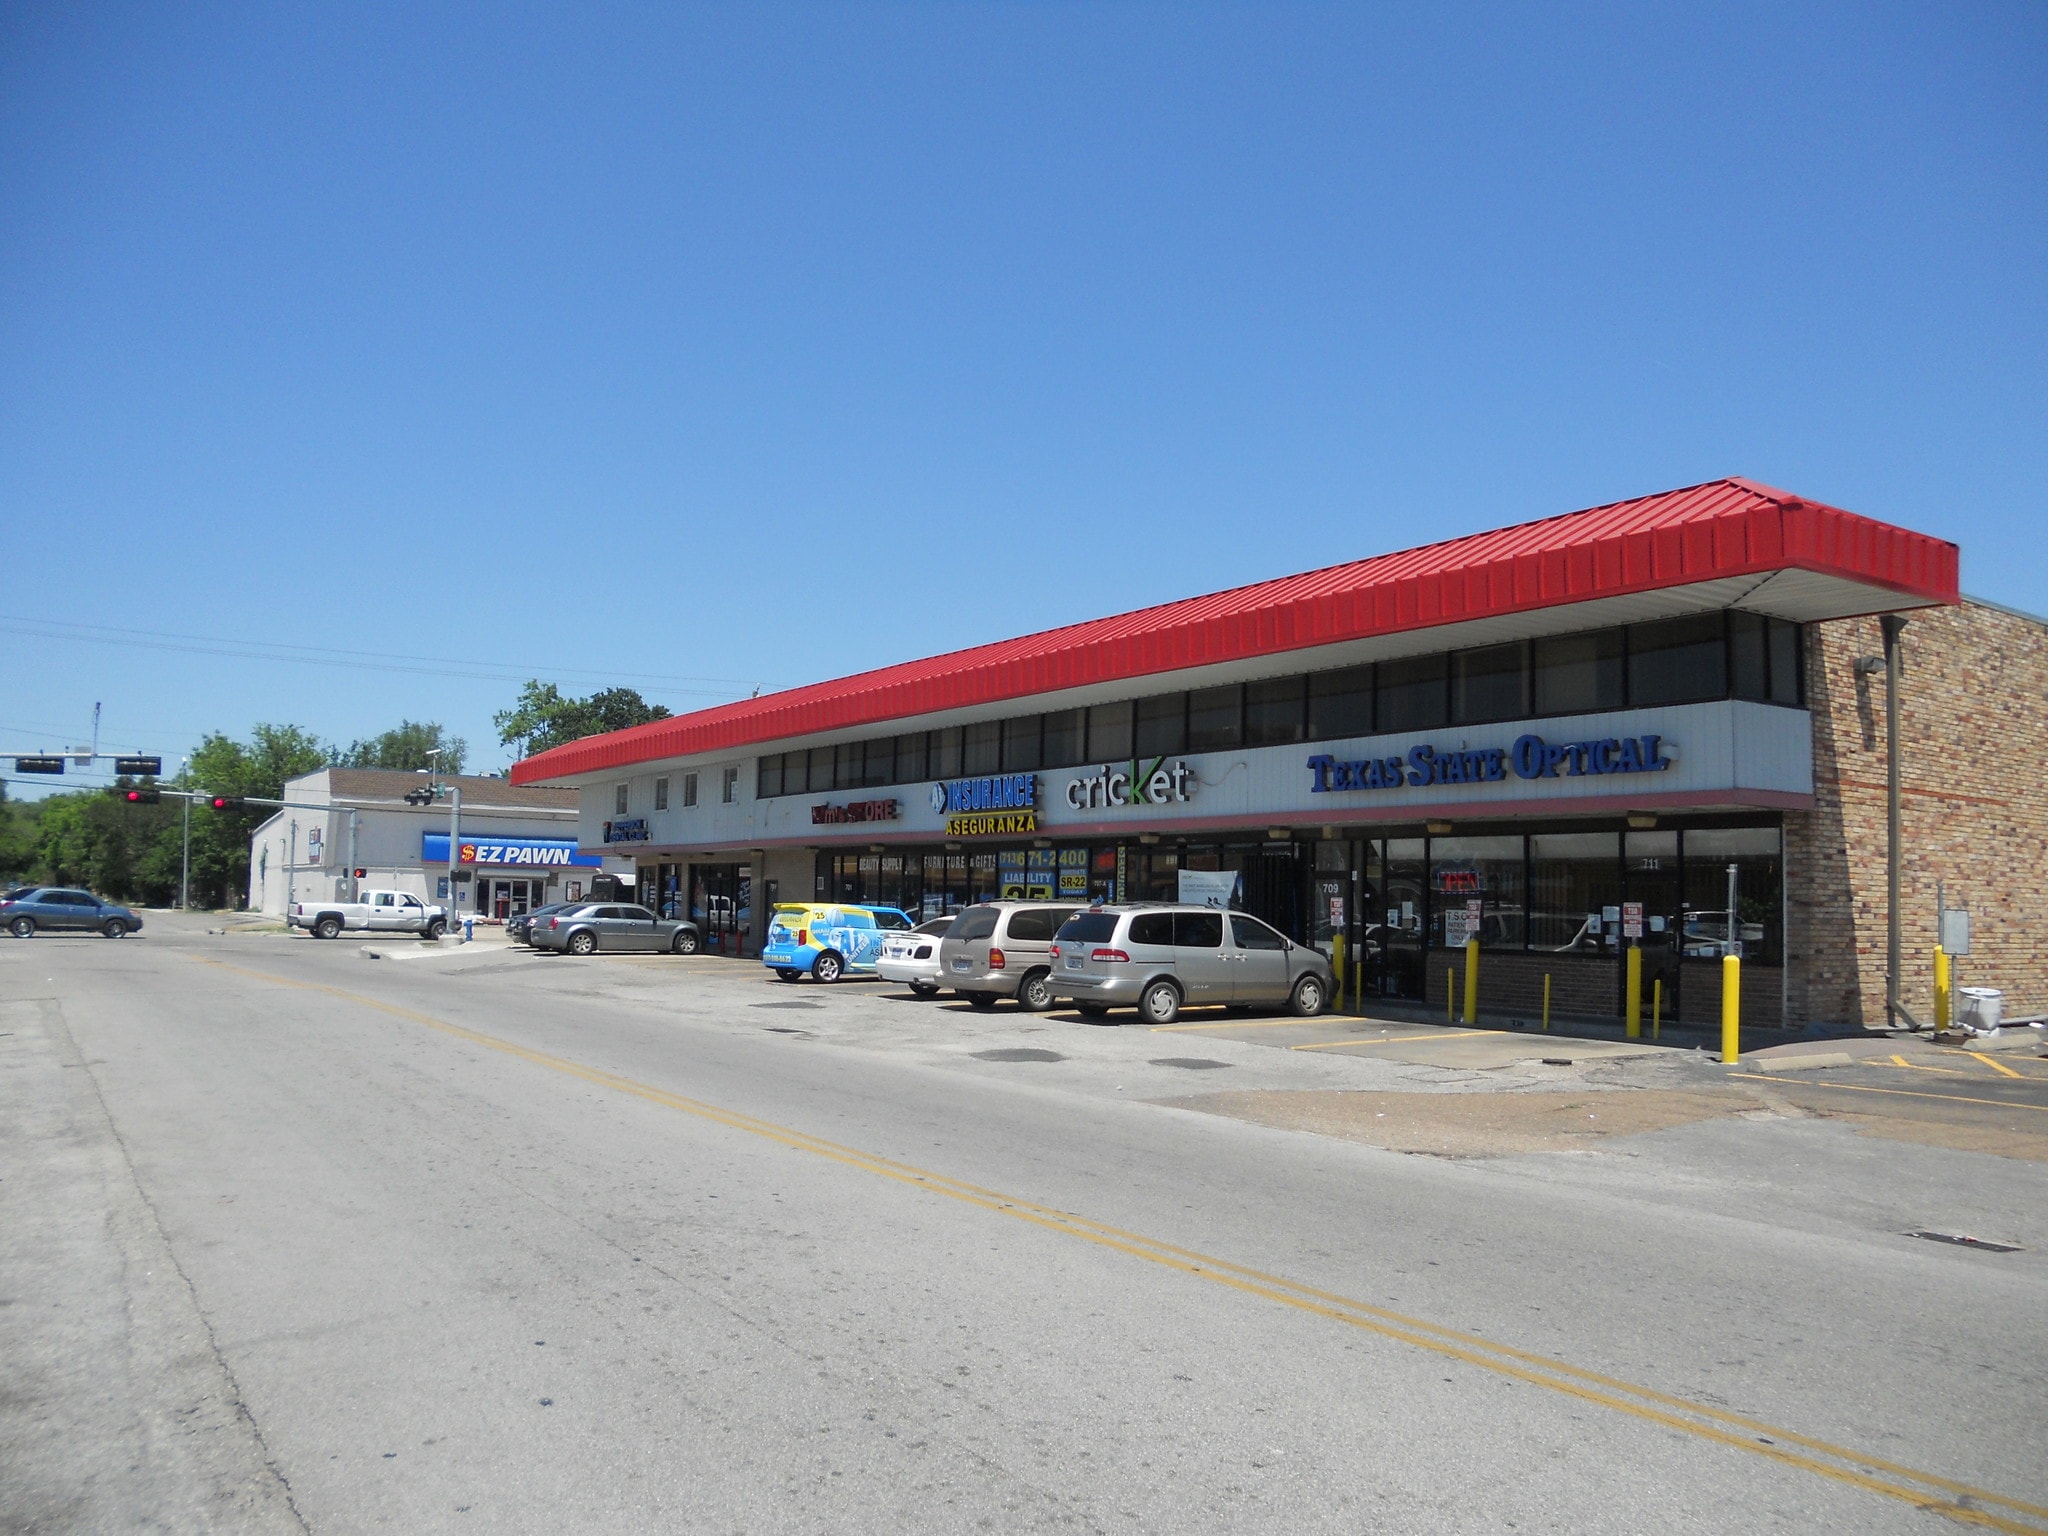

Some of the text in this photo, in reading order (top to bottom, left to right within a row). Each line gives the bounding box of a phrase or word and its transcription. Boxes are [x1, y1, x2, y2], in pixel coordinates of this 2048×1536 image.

[1307, 734, 1671, 792] TEXAS STATE OPTICAL
[947, 774, 1034, 811] INSURANCE
[945, 815, 1036, 835] ASEGURANZA
[475, 846, 502, 863] EZ
[504, 847, 570, 865] PAWN
[924, 855, 965, 869] FURNITURE
[975, 854, 996, 868] GIFTS
[859, 857, 903, 871] BEAUTY SUPPLY
[1643, 859, 1658, 869] 711
[1004, 872, 1051, 883] LIABILITY
[1061, 876, 1086, 887] SR-22
[1323, 884, 1339, 894] 709
